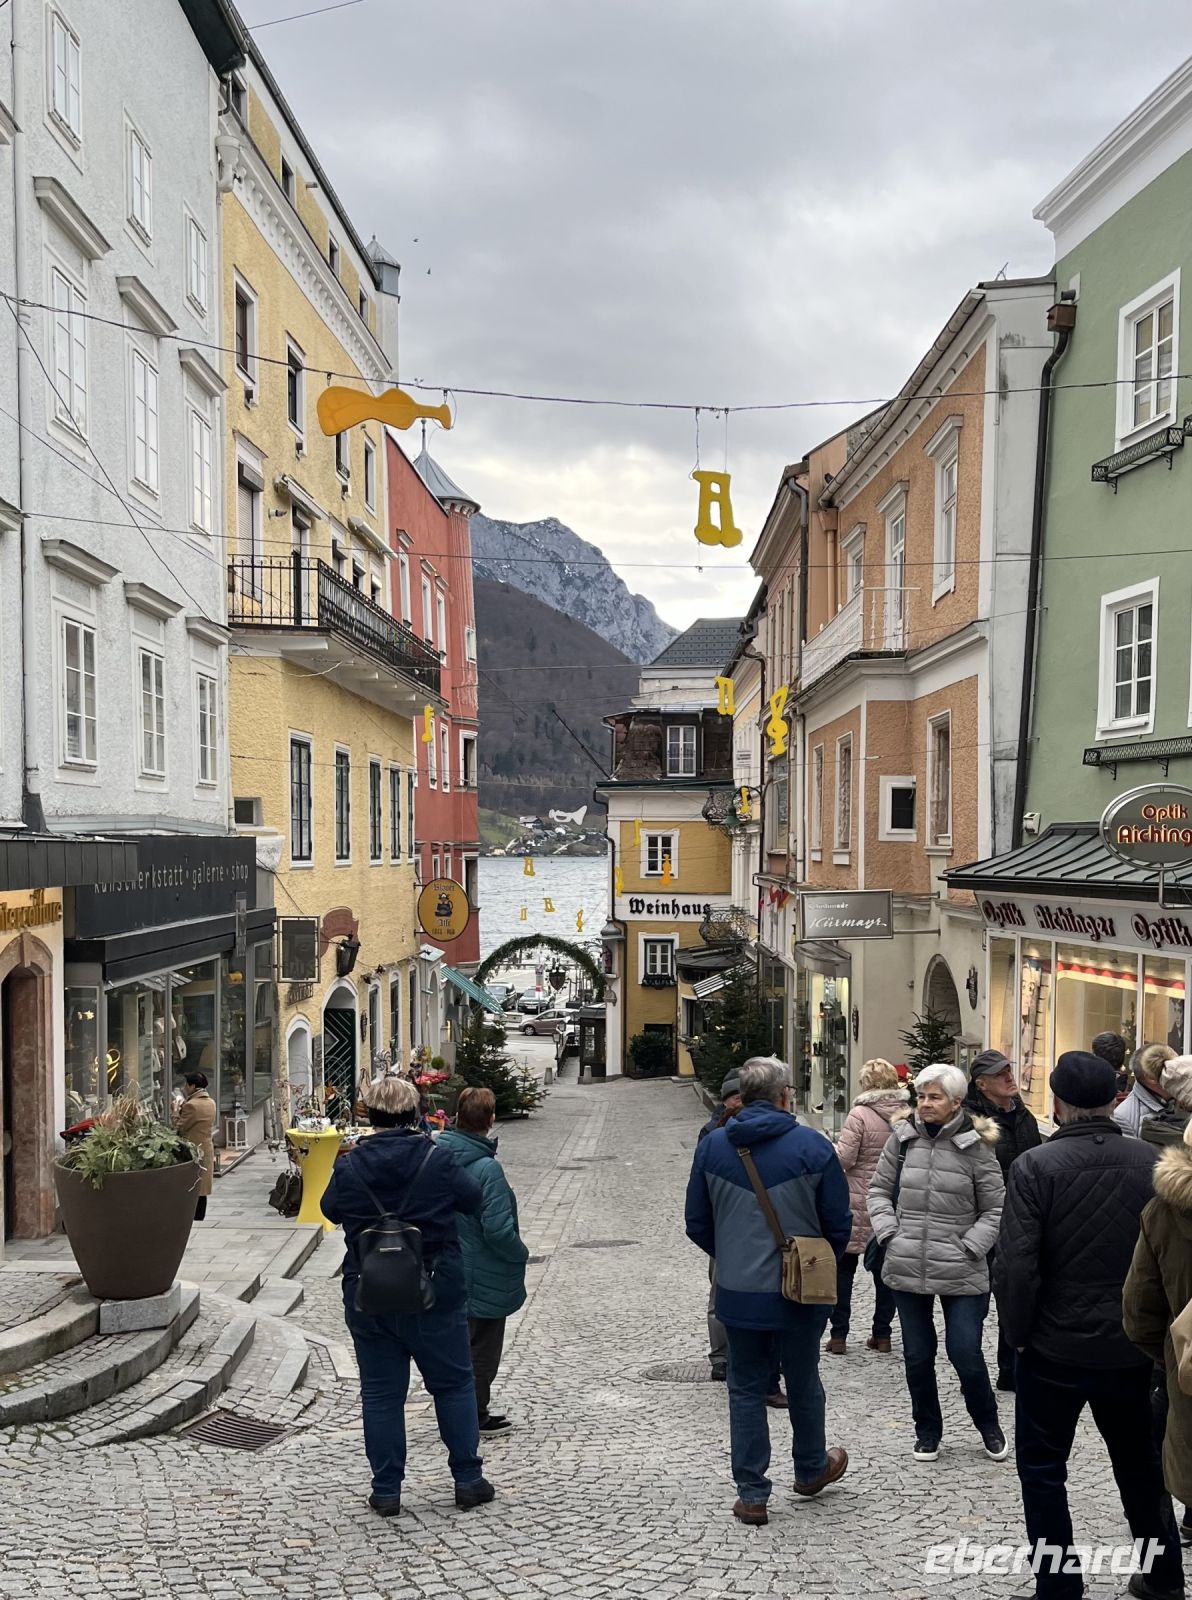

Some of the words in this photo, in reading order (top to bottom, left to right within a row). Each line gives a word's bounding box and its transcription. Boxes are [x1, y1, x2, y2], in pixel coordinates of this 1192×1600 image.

[1142, 804, 1188, 823] Optik
[231, 861, 249, 884] shop
[628, 897, 711, 919] Weinhaus
[981, 900, 1026, 928] Optik
[1033, 904, 1116, 942] Aichinger
[1131, 913, 1192, 949] Optik
